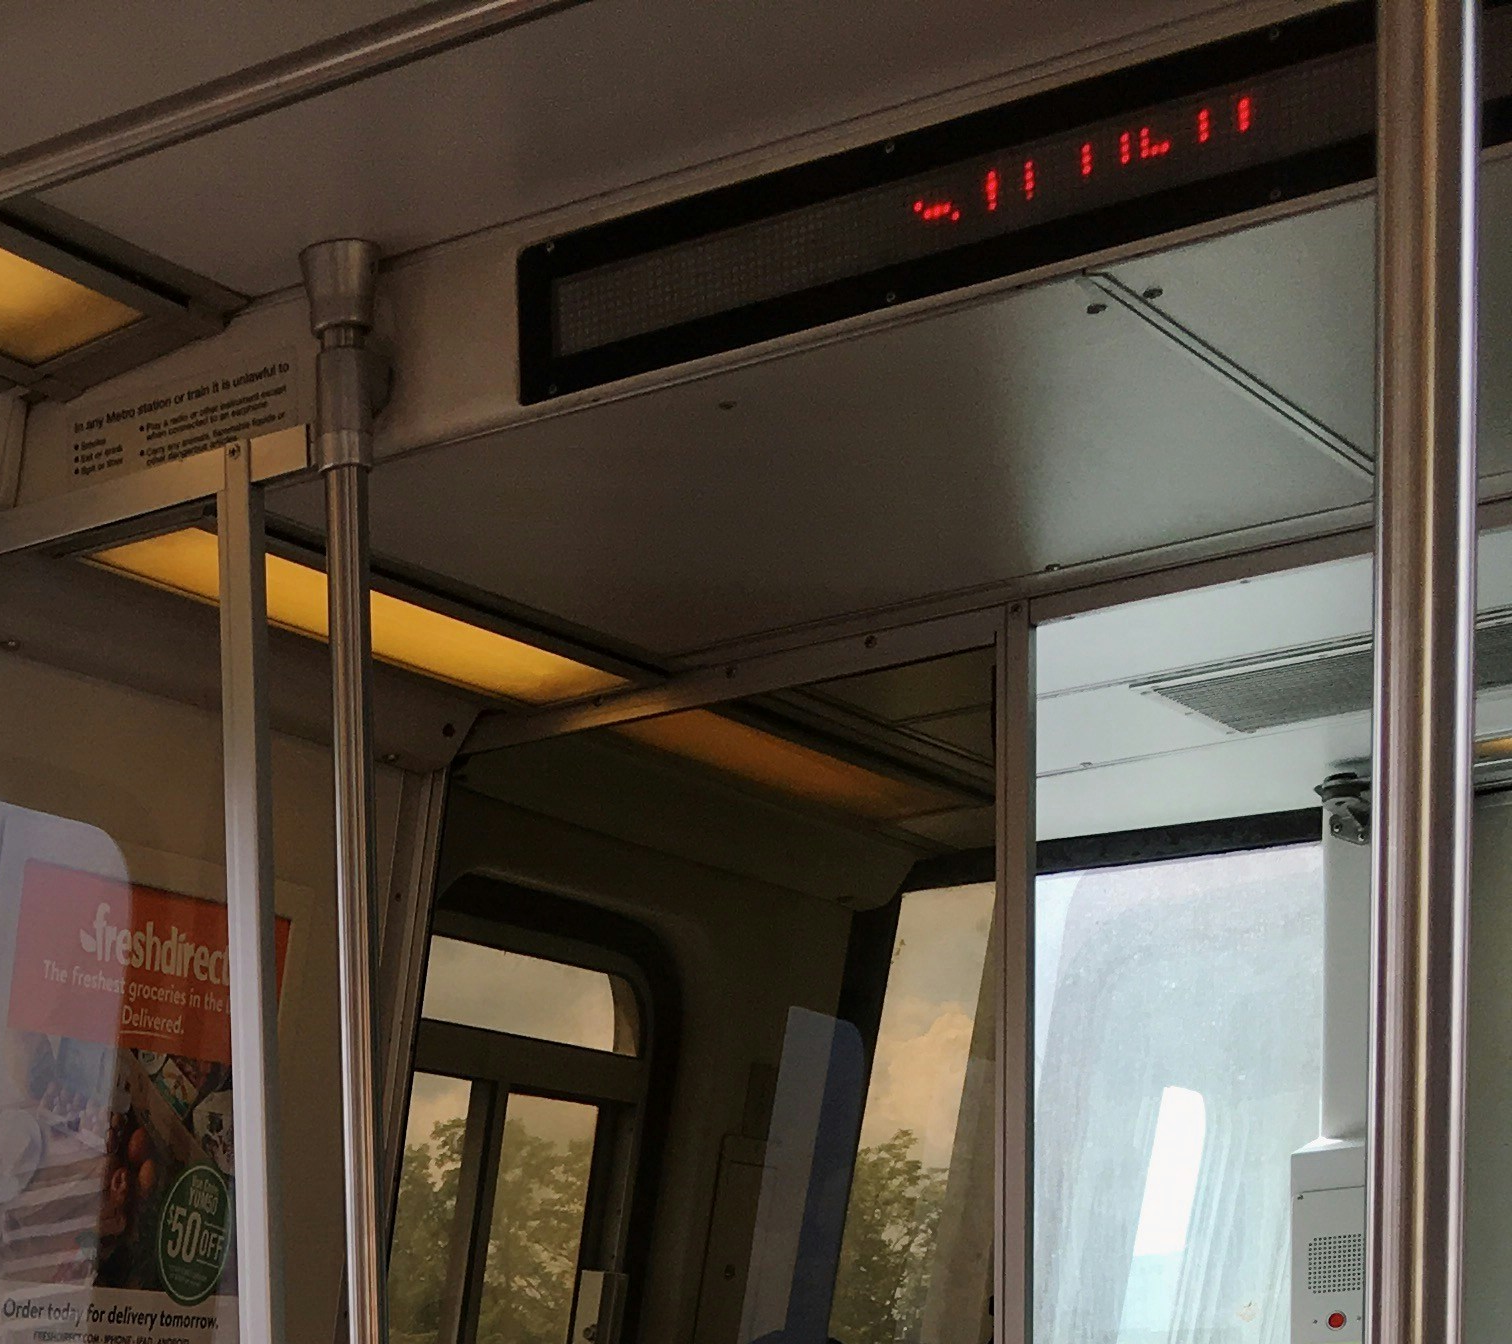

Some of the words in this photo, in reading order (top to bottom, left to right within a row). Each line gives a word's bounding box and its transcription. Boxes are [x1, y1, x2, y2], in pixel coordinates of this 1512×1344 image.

[86, 416, 104, 431] any
[106, 407, 136, 425] Metro
[138, 396, 173, 416] station
[174, 391, 186, 405] or
[187, 384, 211, 401] train
[212, 379, 221, 394] it
[221, 377, 231, 391] is
[232, 365, 277, 388] unlawful
[278, 361, 290, 375] to
[91, 901, 230, 986] freshdirect
[42, 958, 69, 983] The
[71, 964, 126, 995] freshest
[127, 980, 187, 1006] groceries
[188, 987, 201, 1008] in
[204, 992, 223, 1012] the
[121, 1004, 186, 1035] Delivered.
[167, 1203, 203, 1264] $50
[198, 1228, 225, 1262] OFF
[2, 1297, 45, 1320] Order
[47, 1304, 84, 1328] today
[86, 1302, 106, 1323] for
[107, 1305, 158, 1332] delivery
[159, 1310, 220, 1331] tomorrow.
